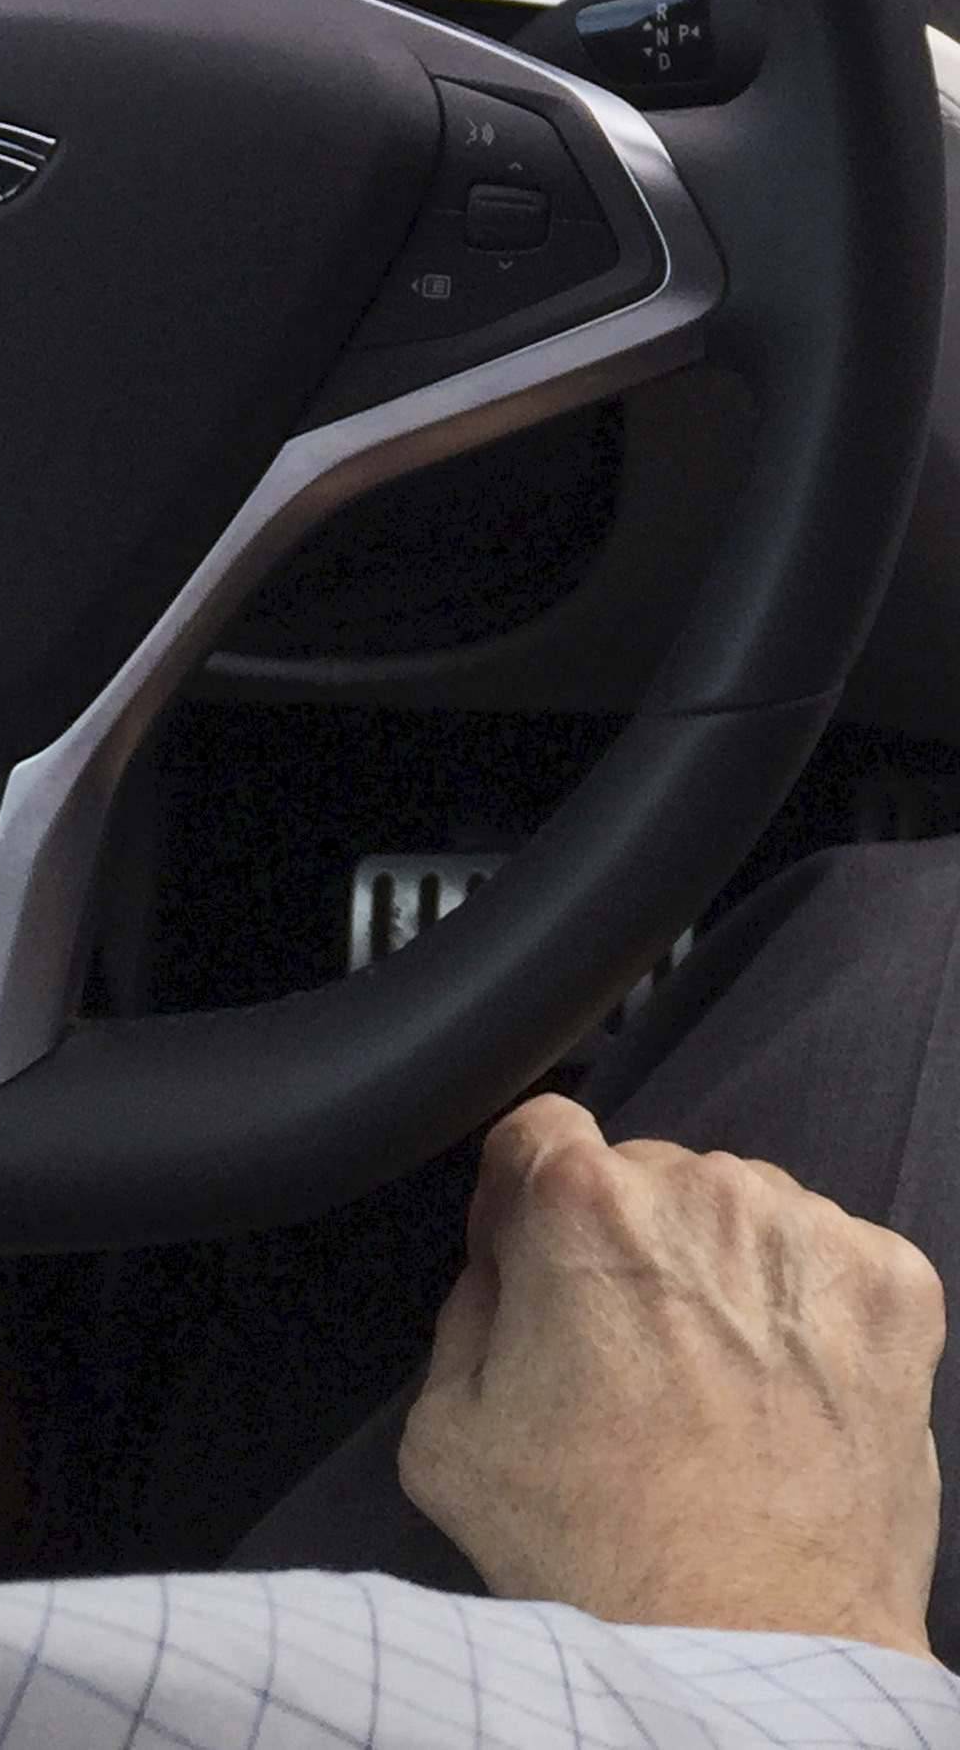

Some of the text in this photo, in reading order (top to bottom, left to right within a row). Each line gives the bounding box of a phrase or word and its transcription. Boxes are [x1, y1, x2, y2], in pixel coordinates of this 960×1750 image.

[656, 2, 668, 21] R
[656, 24, 689, 47] N P
[658, 52, 671, 71] D
